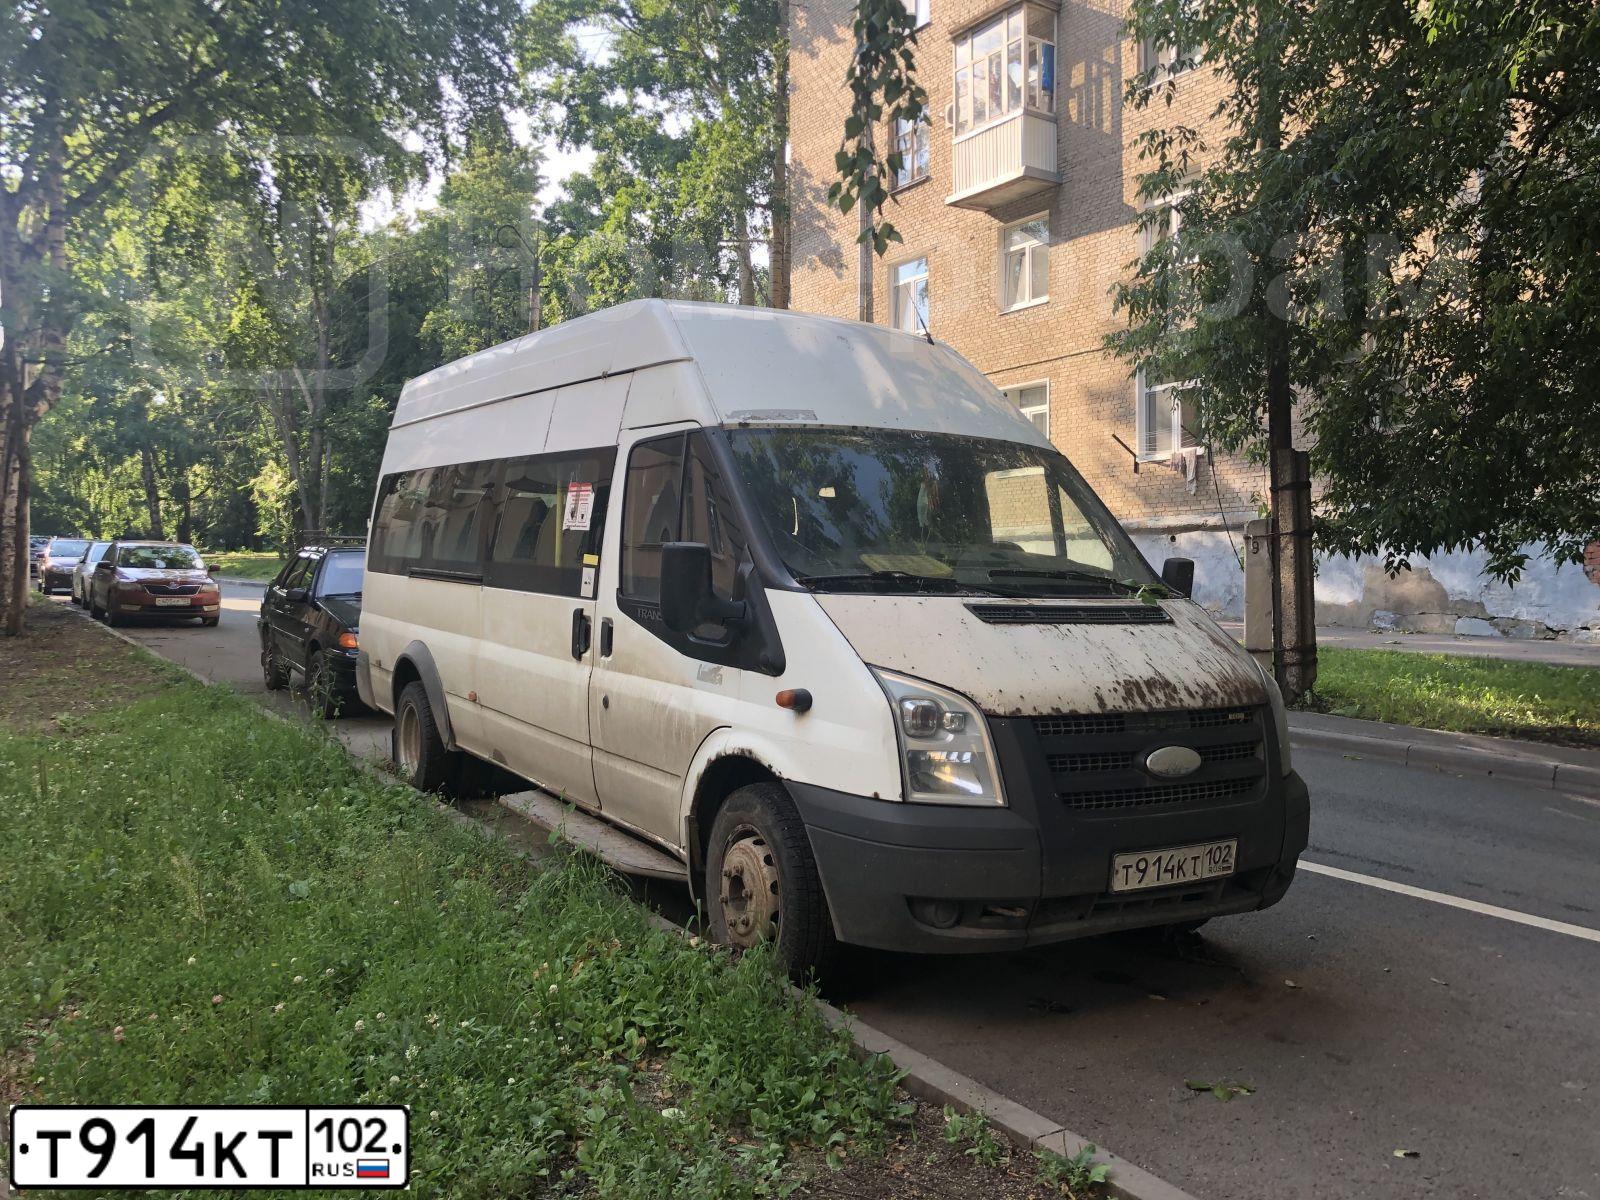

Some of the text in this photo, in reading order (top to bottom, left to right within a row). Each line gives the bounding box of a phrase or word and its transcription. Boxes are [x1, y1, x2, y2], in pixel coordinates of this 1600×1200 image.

[1123, 845, 1231, 885] Т914КТ 102
[1208, 866, 1222, 874] RUS
